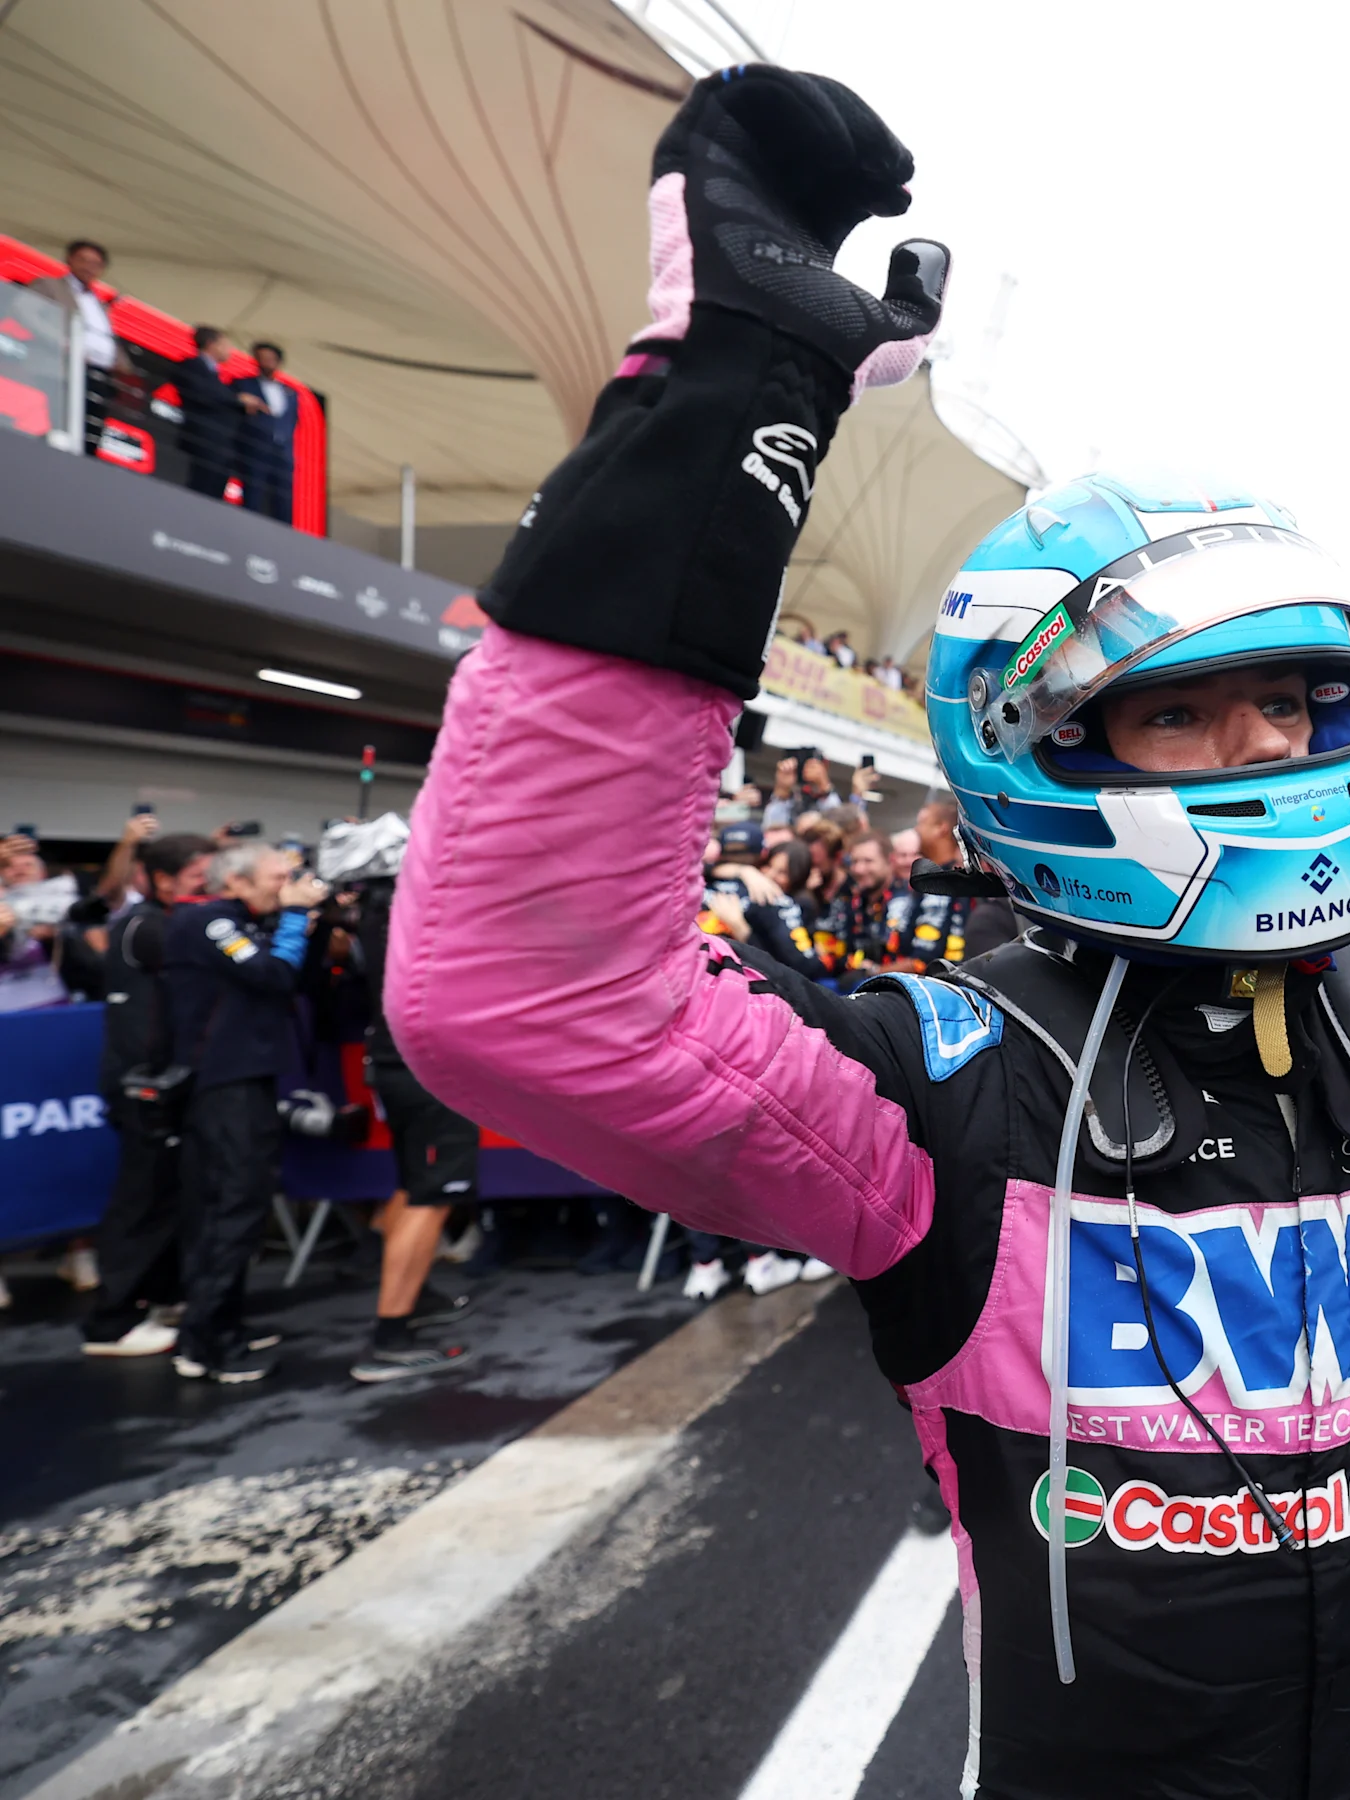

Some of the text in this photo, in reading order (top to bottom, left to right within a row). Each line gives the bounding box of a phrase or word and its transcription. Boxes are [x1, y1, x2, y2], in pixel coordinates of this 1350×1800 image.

[1016, 614, 1066, 675] Castrol
[1315, 685, 1344, 698] BELL
[1057, 727, 1081, 740] BELL
[1271, 783, 1348, 807] IntegraConnect
[1061, 876, 1133, 905] lif3.com
[1, 1094, 106, 1140] PAR
[1141, 1412, 1266, 1444] WATER
[1111, 1476, 1344, 1549] Castrol
